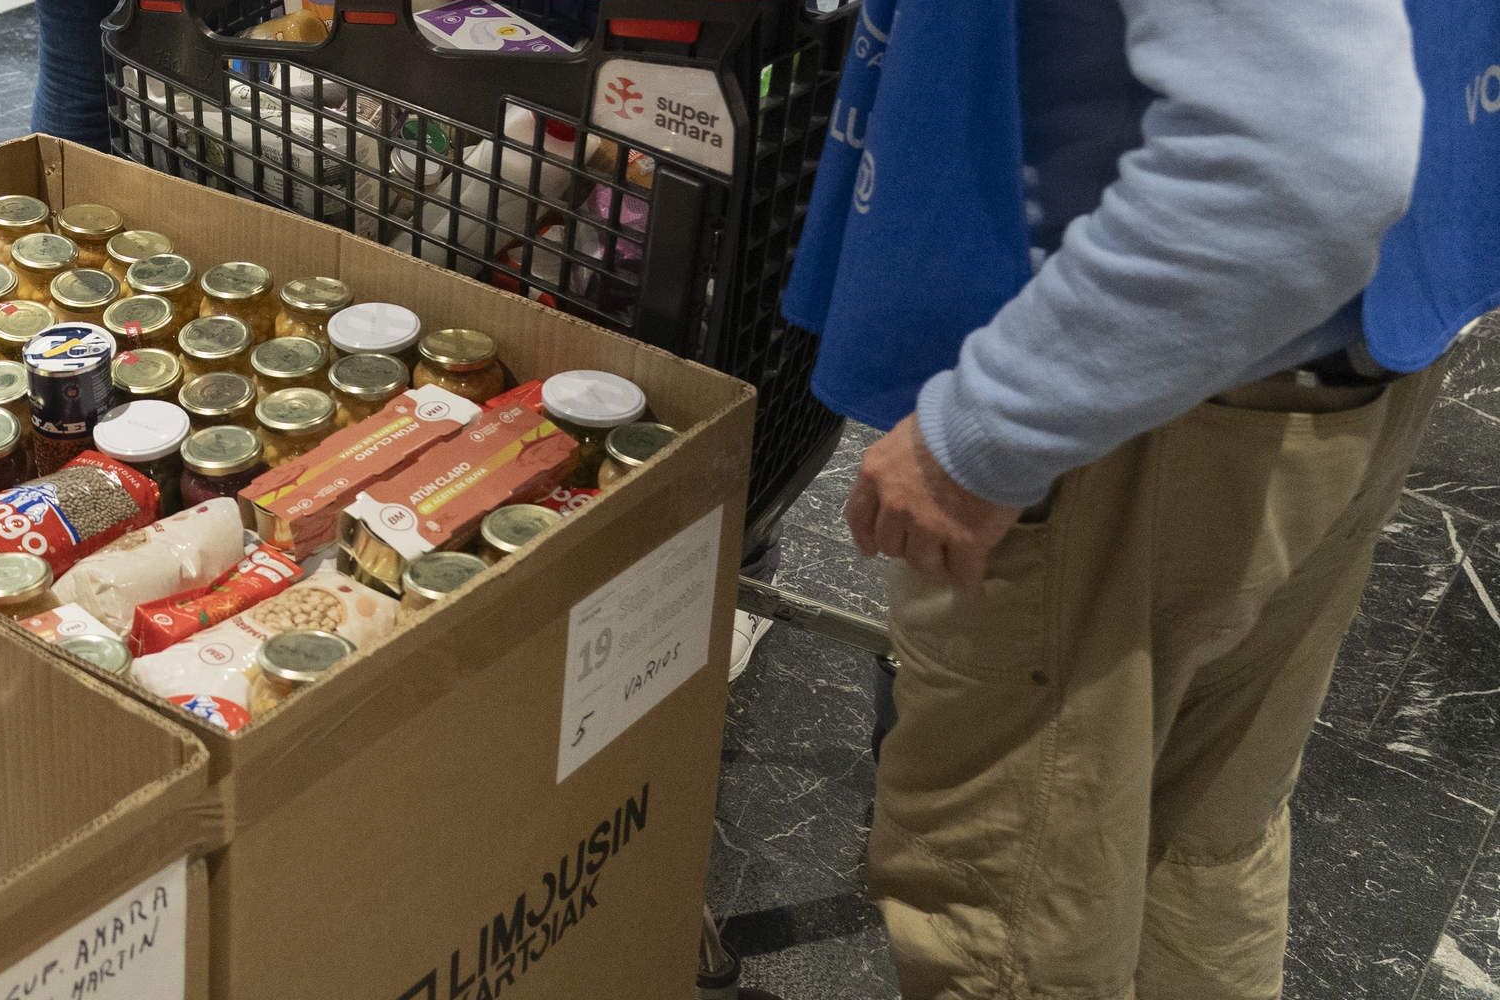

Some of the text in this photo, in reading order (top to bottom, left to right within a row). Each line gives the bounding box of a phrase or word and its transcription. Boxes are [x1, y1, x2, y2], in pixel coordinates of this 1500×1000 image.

[654, 112, 724, 149] amara
[656, 96, 720, 129] super
[424, 404, 444, 417] BM
[338, 442, 363, 459] OLIVA
[354, 420, 420, 461] ATÚN CLARO
[375, 421, 402, 441] ACEITE
[409, 461, 471, 505] ATÚN CLARO
[432, 488, 455, 506] ACEITE
[465, 467, 489, 485] OLIVA
[387, 511, 407, 526] BM
[576, 626, 613, 683] 19
[624, 641, 681, 701] VARIOS
[571, 710, 596, 747] 5
[450, 781, 650, 1000] LIMOUSIN
[74, 886, 168, 970] AMARA
[71, 915, 161, 1000] MARTIN
